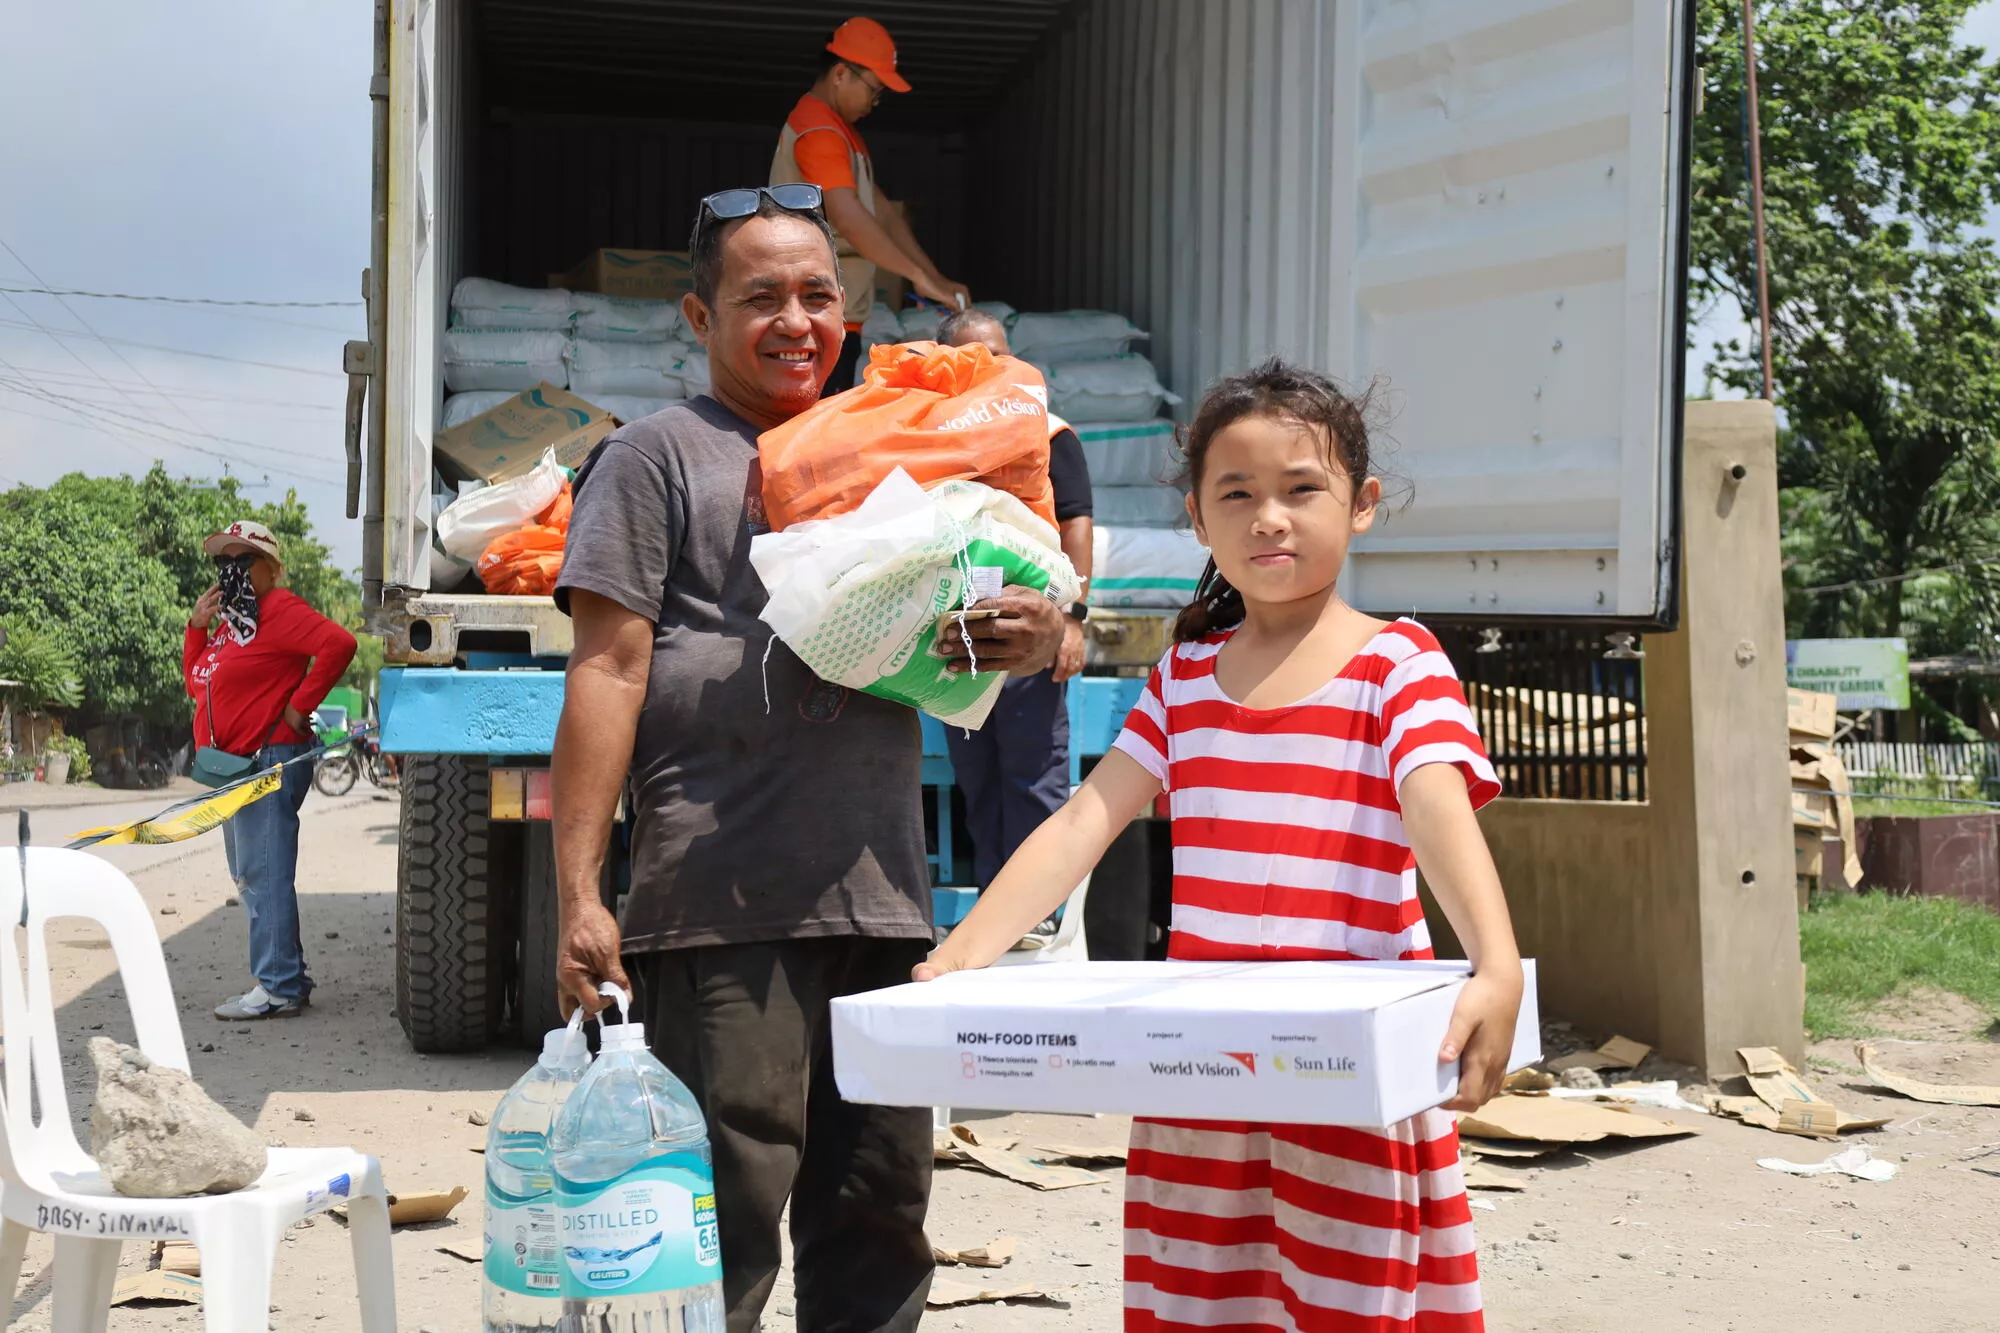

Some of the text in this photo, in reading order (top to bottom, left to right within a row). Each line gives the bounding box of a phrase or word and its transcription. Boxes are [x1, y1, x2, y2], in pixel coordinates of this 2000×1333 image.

[992, 398, 1041, 417] Vision
[957, 1032, 1077, 1047] NON-FOOD ITEMS
[1150, 1061, 1240, 1077] World Vision
[1294, 1056, 1356, 1072] Sun Life
[562, 1208, 659, 1231] DISTILLED
